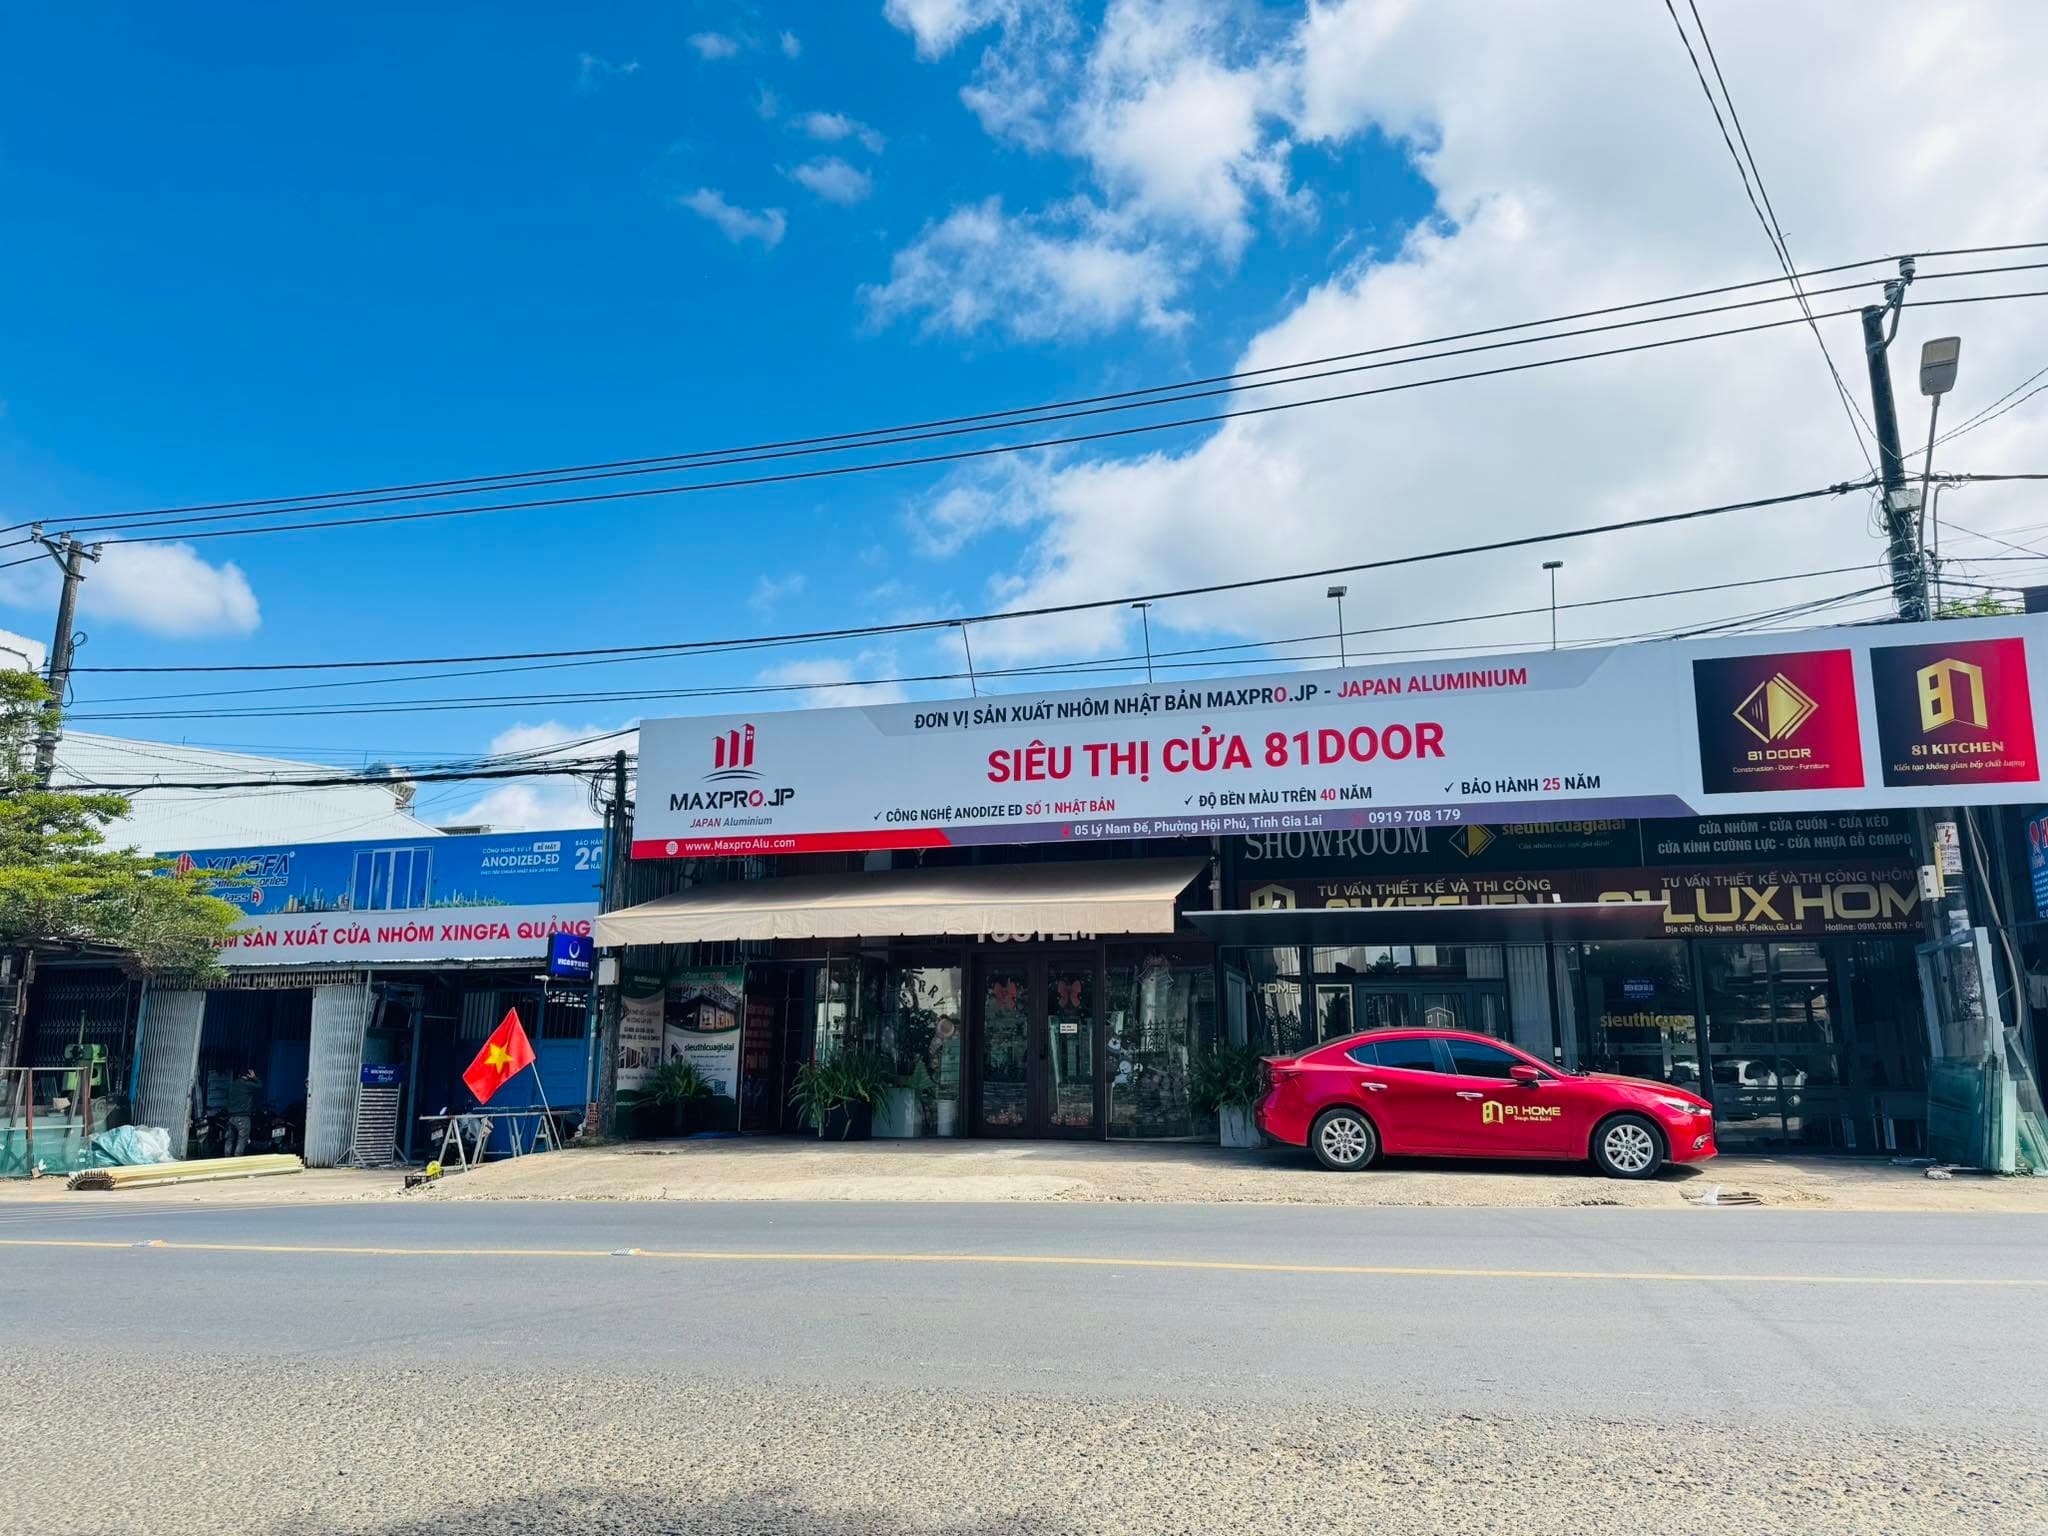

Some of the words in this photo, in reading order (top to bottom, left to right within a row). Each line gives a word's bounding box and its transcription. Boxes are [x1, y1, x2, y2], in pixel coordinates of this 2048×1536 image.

[914, 713, 948, 729] ĐƠN
[954, 710, 968, 729] VỊ
[973, 704, 1007, 725] SẢN
[1011, 701, 1053, 722] XUẤT
[1057, 697, 1109, 718] NHÔM
[1114, 692, 1161, 715] NHẬT
[1165, 688, 1201, 711] BẢN
[1207, 684, 1318, 708] MAXPRO.JP
[1337, 677, 1401, 698] JAPAN
[1407, 667, 1527, 693] ALUMINIUM
[987, 739, 1072, 783] SIÊU
[1083, 740, 1150, 783] THỊ
[1162, 725, 1253, 773] CỬA
[1265, 722, 1446, 768] 81DOOR
[1748, 751, 1762, 761] 81
[1766, 748, 1812, 760] DOOR
[1911, 744, 1928, 756] 81
[1932, 741, 2005, 756] KITCHEN
[1732, 765, 1774, 773] Construction
[1778, 763, 1794, 771] Door
[1799, 762, 1830, 770] Furniture
[1926, 762, 1949, 772] không
[1951, 761, 1968, 771] gian
[1970, 759, 1983, 770] bếp
[1985, 759, 2001, 768] chất
[1462, 777, 1491, 795] BẢO
[1495, 777, 1539, 793] HÀNH
[1542, 777, 1561, 791] 25
[1565, 773, 1600, 790] NĂM
[670, 788, 795, 811] MAXPRO.JP
[1199, 793, 1217, 810] ĐỘ
[1220, 788, 1246, 805] BỀN
[1248, 789, 1279, 805] MÀU
[1282, 786, 1317, 802] TRÊN
[1320, 788, 1336, 801] 40
[1340, 784, 1372, 800] NĂM
[886, 807, 918, 822] CÔNG
[921, 805, 951, 822] NGHỆ
[954, 804, 1005, 821] ANODIZE
[1008, 804, 1022, 816] ED
[1025, 799, 1042, 816] SỐ
[1045, 803, 1050, 814] 1
[1054, 799, 1087, 816] NHẬT
[1090, 796, 1116, 812] BẢN
[1368, 810, 1402, 825] 0919
[1405, 809, 1431, 823] 708
[1436, 808, 1461, 821] 179
[690, 818, 721, 829] JAPAN
[723, 816, 773, 828] Aluminium
[1074, 824, 1089, 836] 05
[1091, 822, 1103, 838] Lý
[1105, 822, 1131, 835] Nam
[1133, 818, 1151, 835] Đế,
[1154, 817, 1198, 836] Phường
[1201, 816, 1221, 832] Hội
[1223, 814, 1250, 831] Phú,
[1282, 814, 1301, 828] Gia
[1304, 813, 1323, 826] Lai
[1699, 820, 1722, 835] CỬA
[1724, 820, 1759, 834] NHÔM
[1769, 816, 1793, 832] CỬA
[1244, 827, 1430, 861] SHOWROOM
[1657, 839, 1680, 854] CỬA
[1755, 837, 1777, 853] LỰC
[1787, 834, 1811, 849] CỬA
[1814, 834, 1847, 850] NHỰA
[481, 854, 559, 868] ANODIZED-ED
[1317, 883, 1339, 897] TƯ
[1344, 880, 1373, 896] VẤN
[1376, 878, 1419, 895] THIẾT
[1424, 876, 1445, 893] KẾ
[1450, 878, 1469, 893] VÀ
[1473, 880, 1498, 892] THI
[1503, 876, 1551, 891] CÔNG
[1661, 876, 1680, 888] TƯ
[1684, 873, 1710, 887] VẤN
[1713, 871, 1753, 886] THIẾT
[1758, 870, 1778, 885] KẾ
[1781, 871, 1798, 884] VÀ
[1799, 872, 1822, 884] THI
[1825, 868, 1867, 882] CÔNG
[1661, 886, 1784, 923] LUX
[1792, 883, 1919, 921] HOM
[244, 925, 277, 947] SẢN
[283, 921, 328, 946] XUẤT
[334, 921, 370, 944] CỬA
[378, 921, 434, 943] NHÔM
[440, 923, 510, 942] XINGFA
[1716, 923, 1733, 932] Nam
[1790, 922, 1802, 931] Lai
[1257, 983, 1299, 994] HOME
[1505, 1105, 1518, 1115] 81
[1522, 1106, 1561, 1116] HOME
